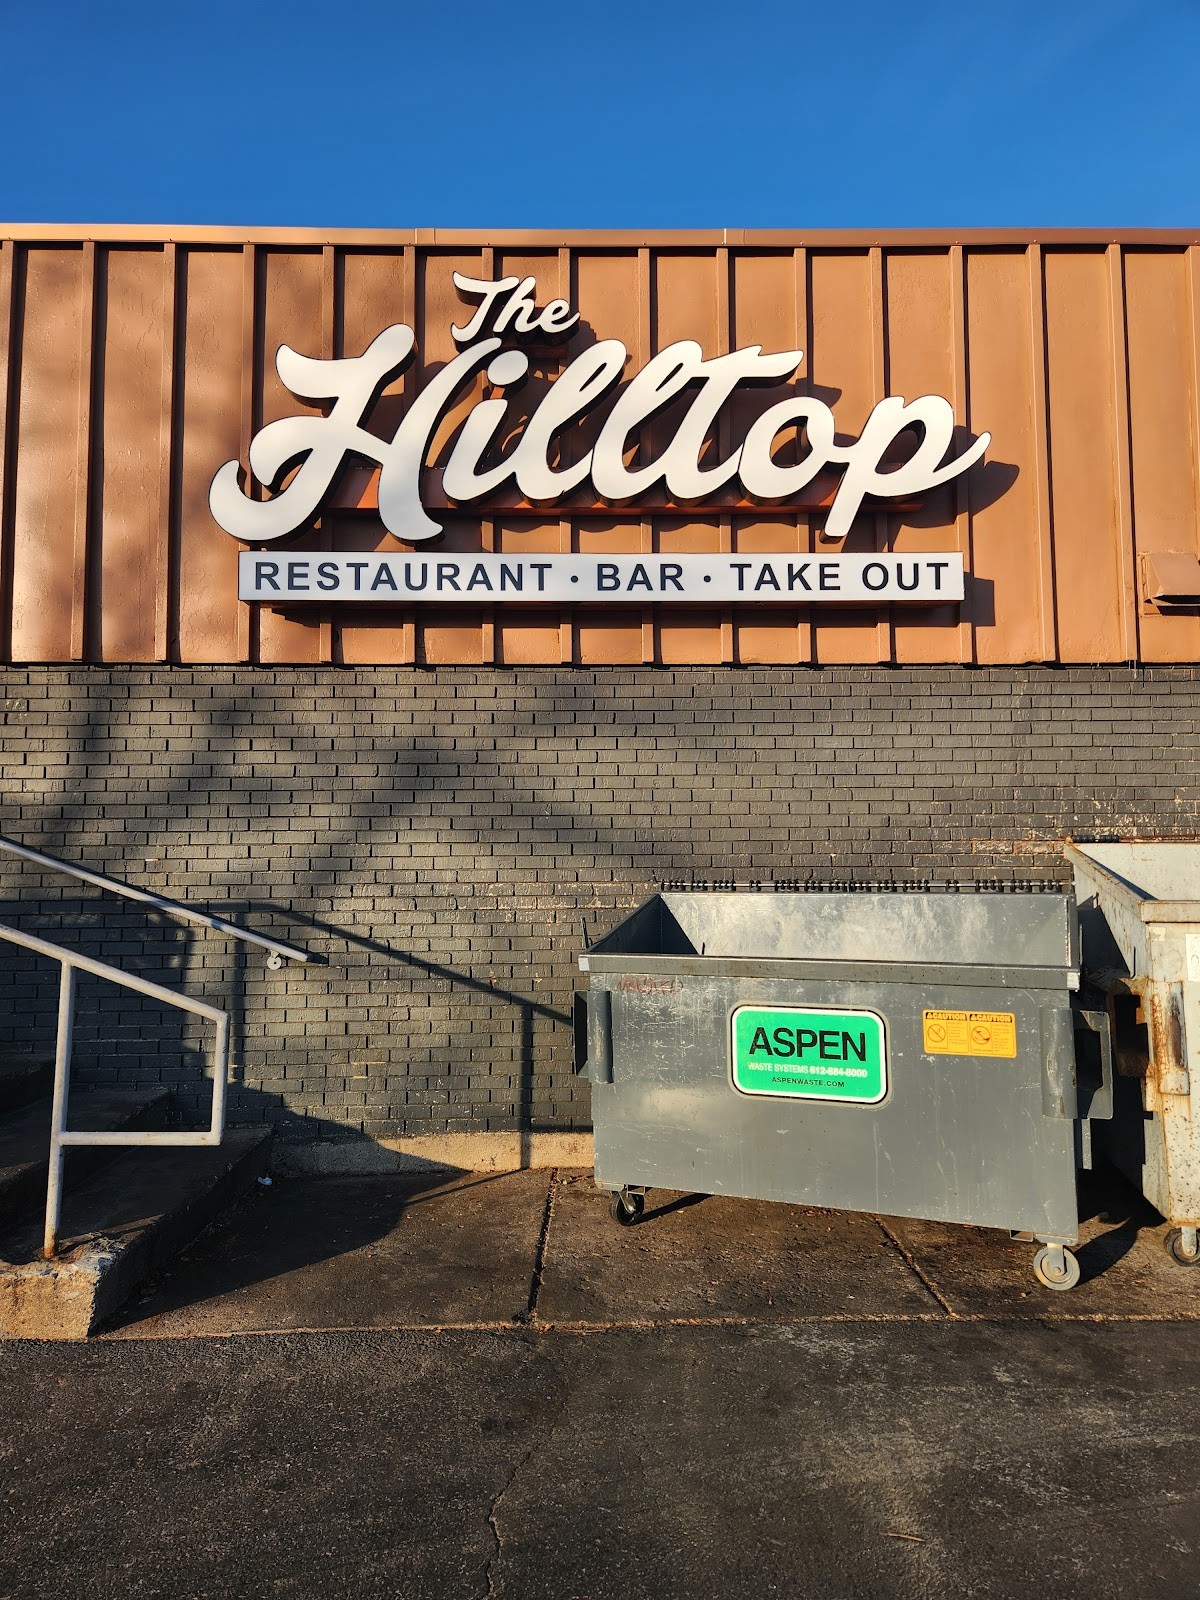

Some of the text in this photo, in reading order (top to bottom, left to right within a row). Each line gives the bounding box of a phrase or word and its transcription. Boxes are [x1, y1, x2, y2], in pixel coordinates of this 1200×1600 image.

[452, 270, 580, 343] The
[208, 322, 991, 543] Hilltop
[254, 561, 950, 592] RESTAURANT BAR TAKE OUT
[933, 1012, 1011, 1023] CAUTION CAUTION
[748, 1026, 867, 1062] ASPEN
[748, 1062, 868, 1078] WASTE SYSTEMS 612-884-8000
[771, 1076, 845, 1088] ASPENWASTE.COM
